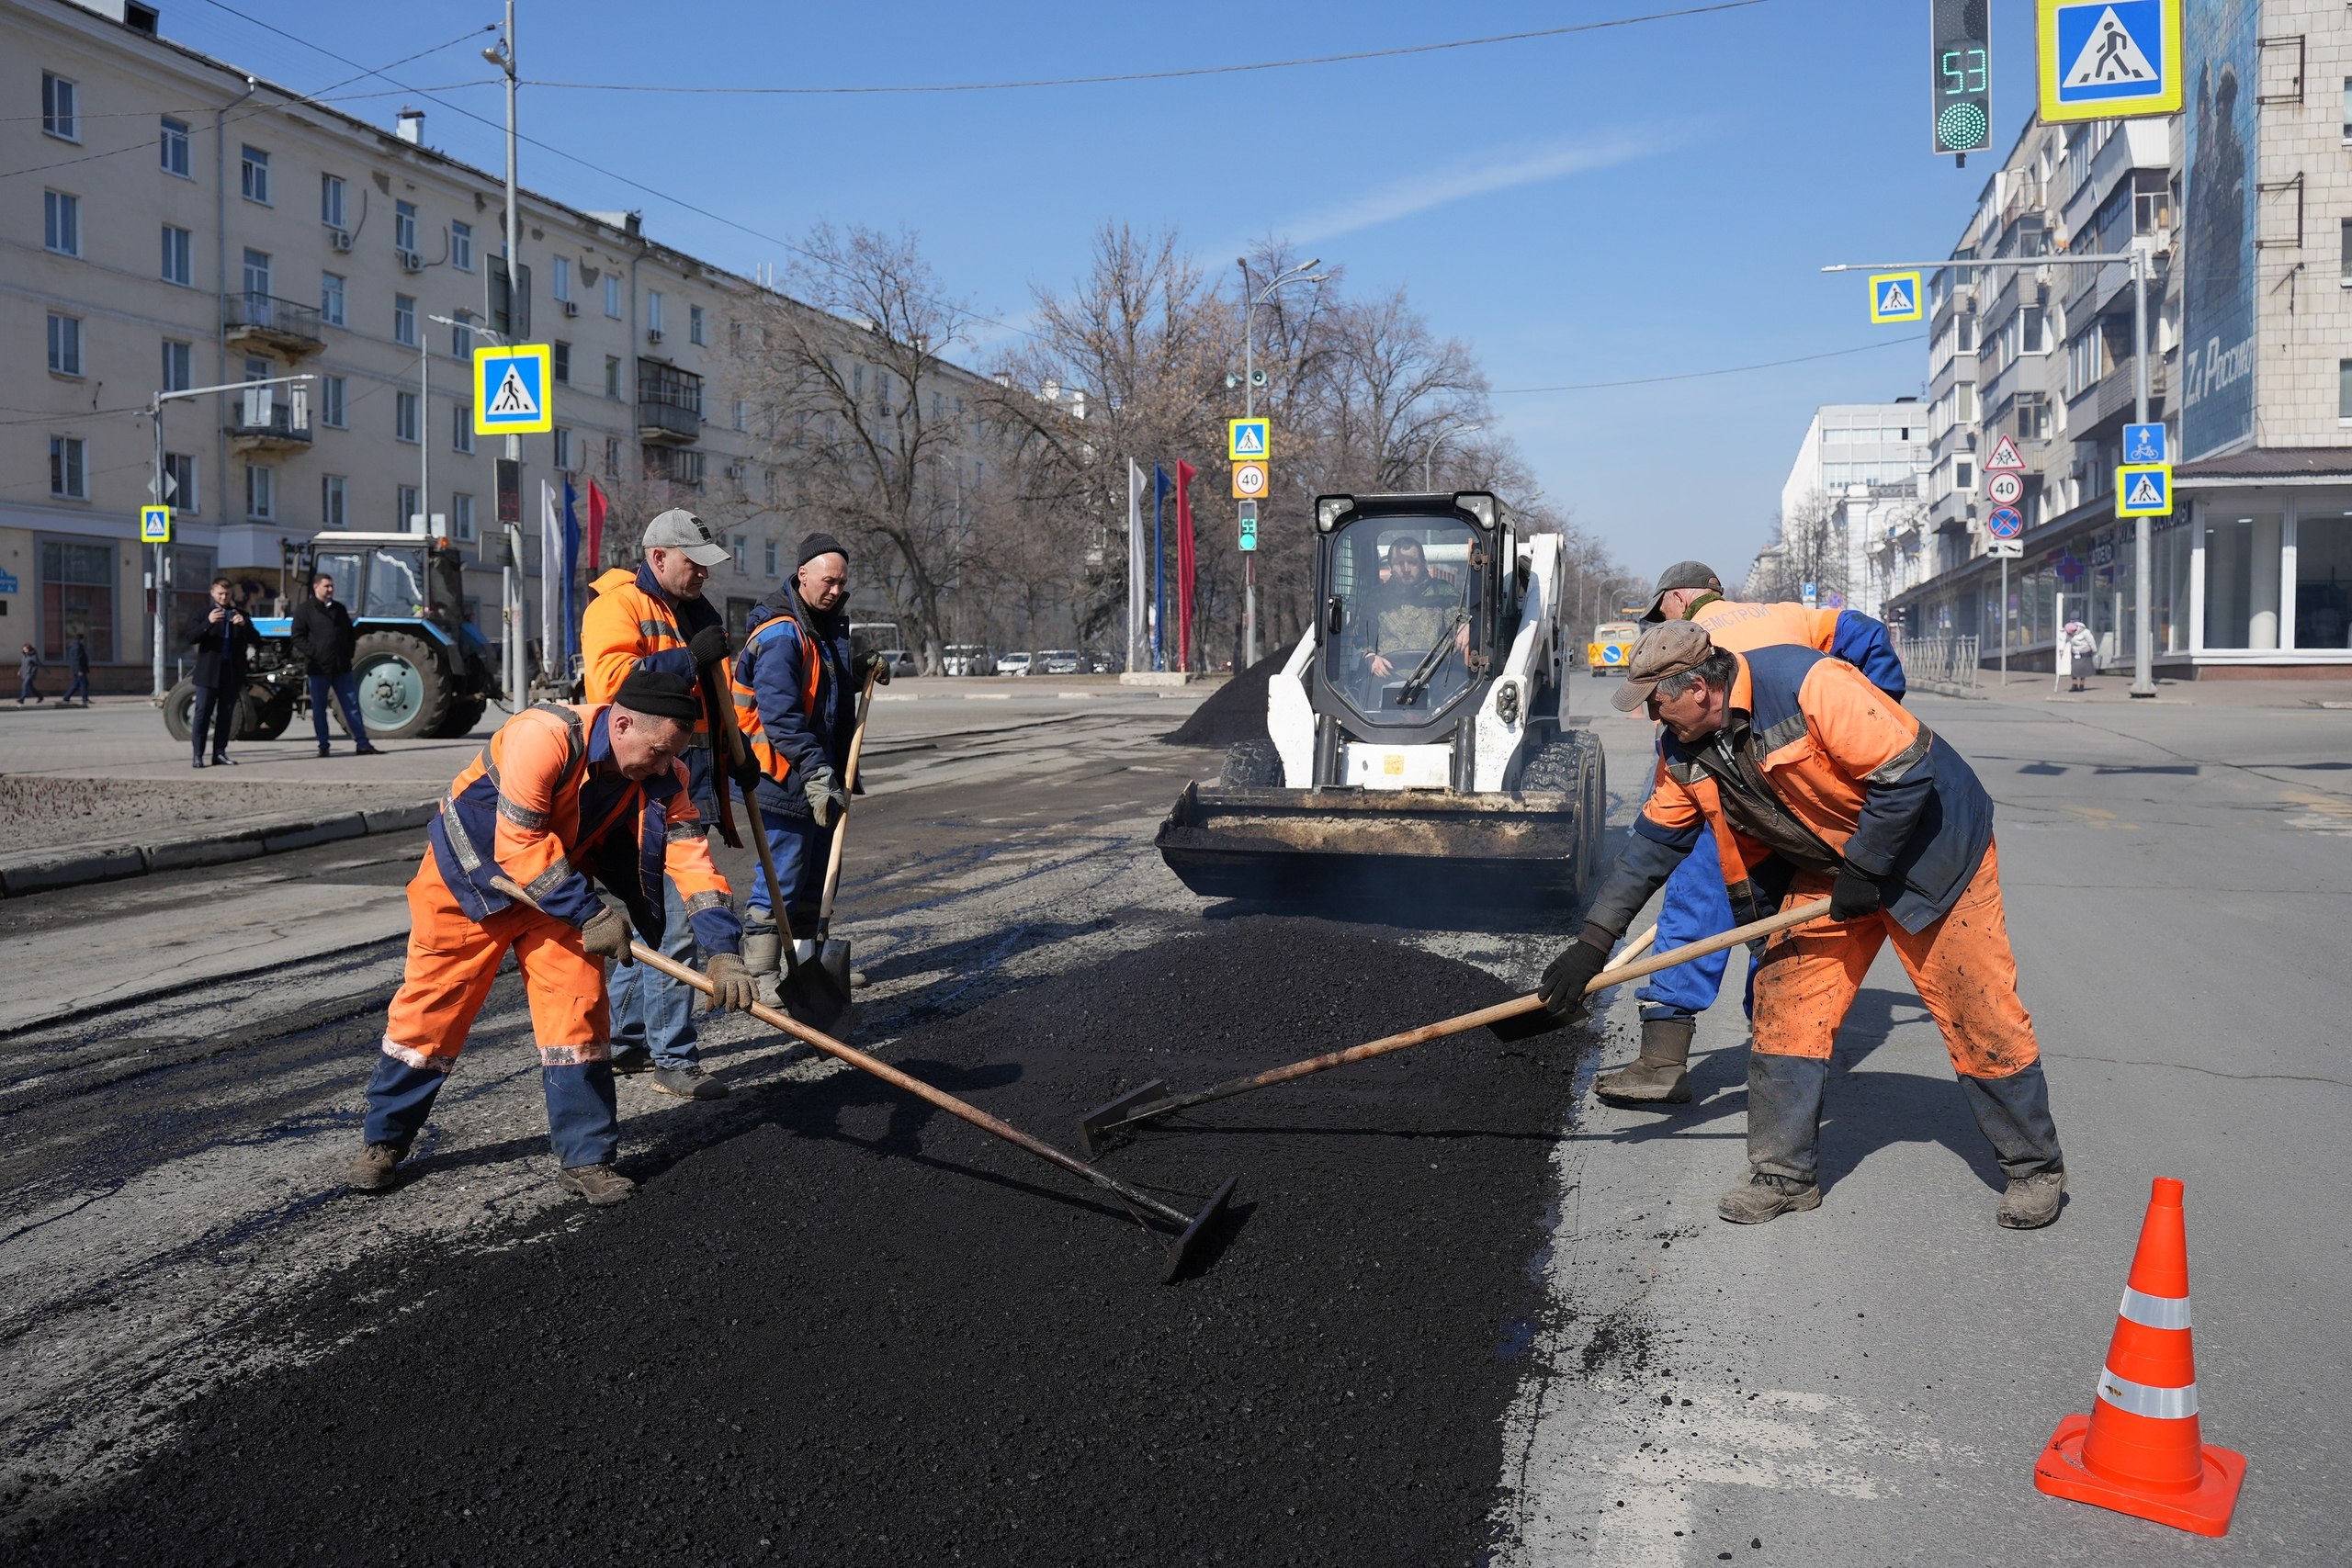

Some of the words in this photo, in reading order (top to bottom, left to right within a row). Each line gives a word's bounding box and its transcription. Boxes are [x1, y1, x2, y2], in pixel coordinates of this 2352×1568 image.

[1943, 50, 1986, 95] 53
[1242, 473, 1259, 486] 40
[1996, 482, 2014, 495] 40
[1241, 518, 1256, 534] 53
[1805, 583, 1815, 595] P
[1700, 603, 1771, 632] ЕМСТРОЙ
